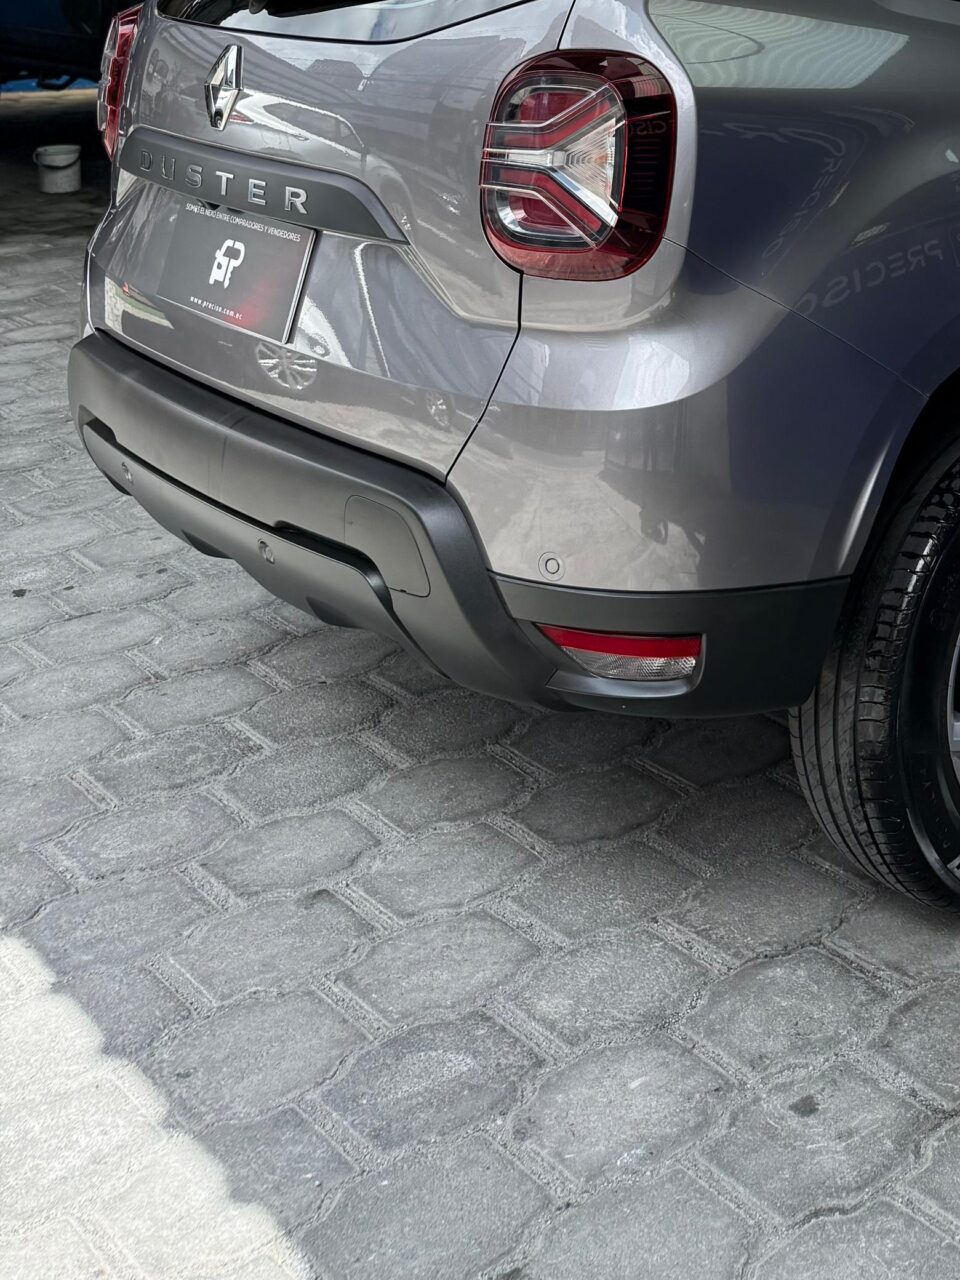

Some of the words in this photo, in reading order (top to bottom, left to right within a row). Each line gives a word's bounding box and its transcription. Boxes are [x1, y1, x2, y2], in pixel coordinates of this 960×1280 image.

[140, 149, 307, 215] DUSTER
[230, 215, 264, 232] COMPRADORES
[268, 226, 301, 242] VENDEDORES
